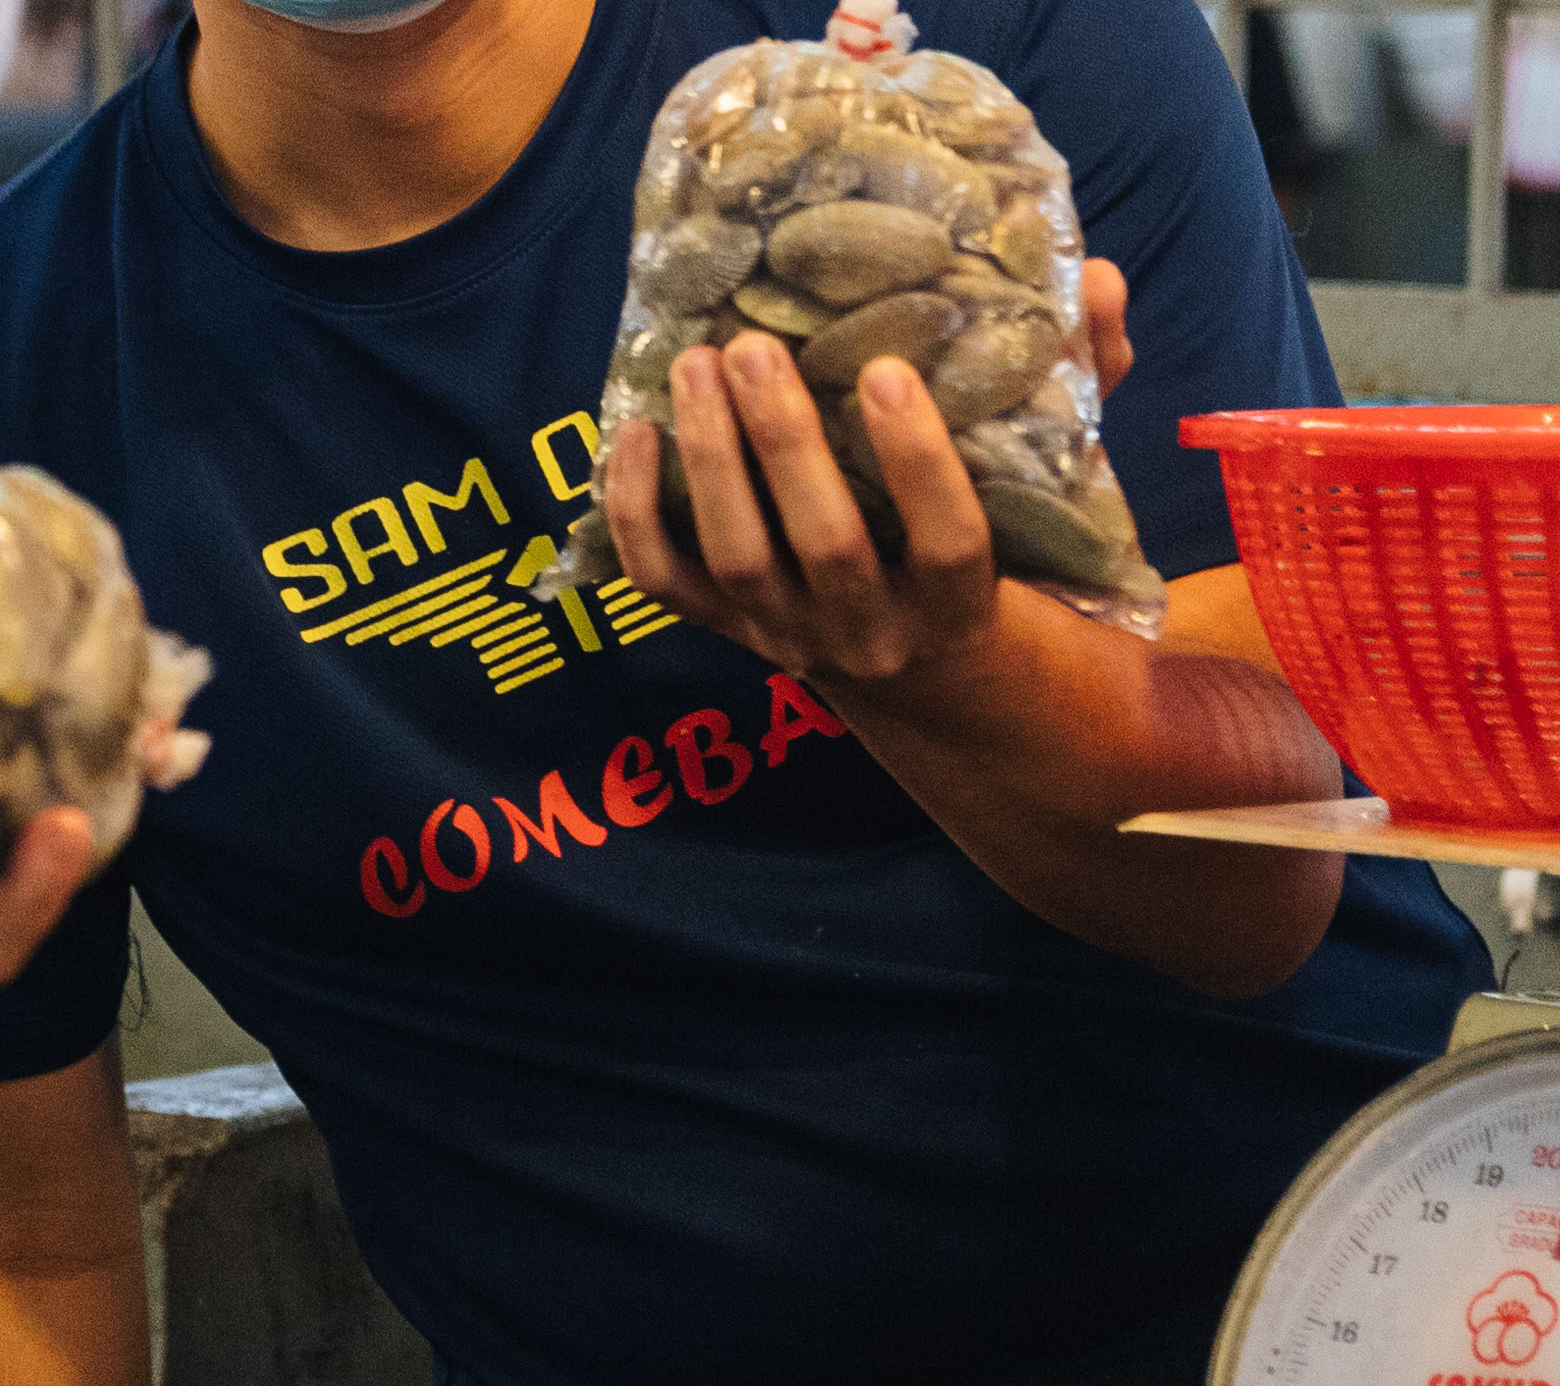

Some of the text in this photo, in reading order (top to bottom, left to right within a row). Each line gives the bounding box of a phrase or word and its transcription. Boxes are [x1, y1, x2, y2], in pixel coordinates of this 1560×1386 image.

[262, 458, 511, 613] SAM
[1475, 1164, 1504, 1187] 19
[1421, 1201, 1449, 1223] 18
[1369, 1254, 1399, 1275] 17
[1332, 1320, 1359, 1343] 16
